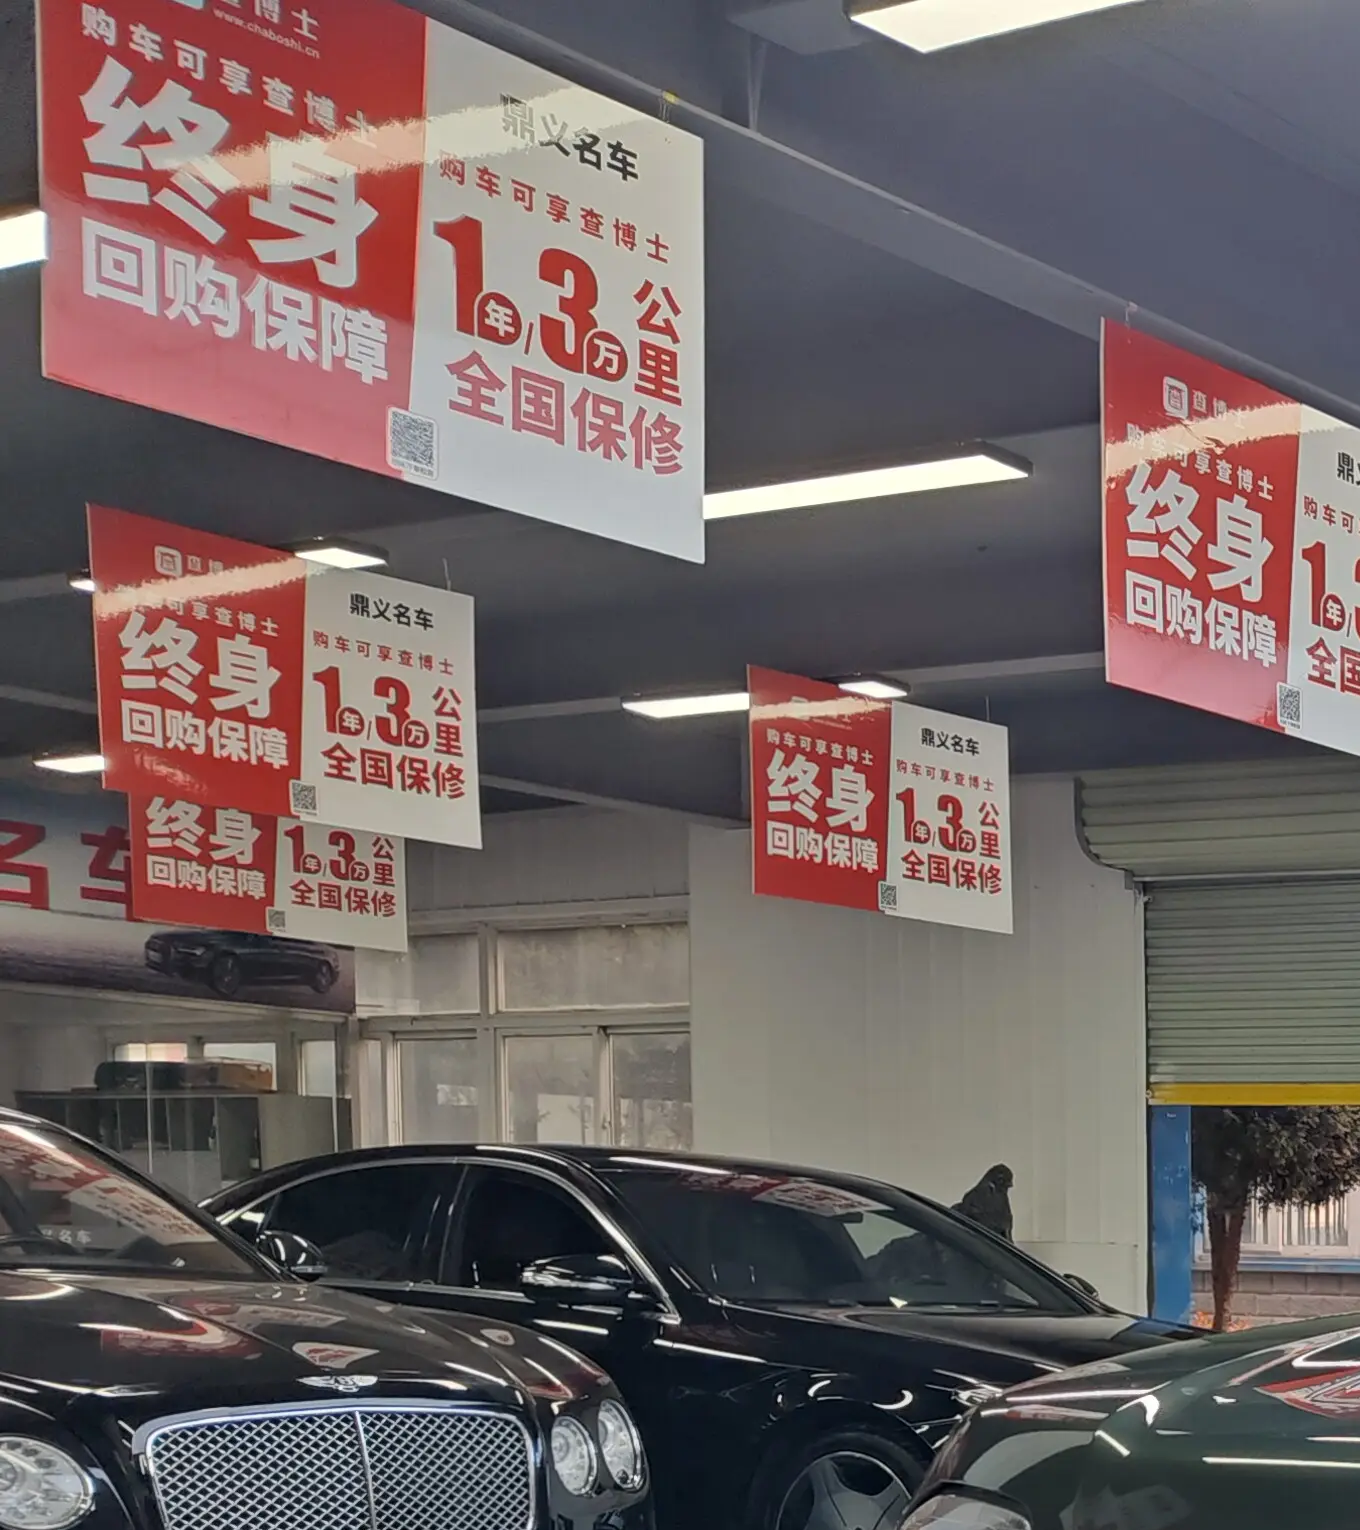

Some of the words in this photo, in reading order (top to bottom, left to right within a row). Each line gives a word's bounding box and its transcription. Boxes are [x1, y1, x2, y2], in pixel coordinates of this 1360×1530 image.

[212, 6, 321, 59] www.chaboshi.cn
[219, 0, 320, 41] 博士
[80, 3, 378, 148] 购车可享查博士
[500, 93, 640, 182] 鼎义名车
[79, 54, 378, 289] 终身
[439, 151, 670, 264] 购车可享查博士
[80, 217, 389, 385] 回购保障
[444, 350, 685, 477] 全国保修
[1125, 462, 1275, 602] 终身
[349, 593, 435, 631] 鼎义名车
[1125, 569, 1277, 668] 回购保障
[118, 611, 281, 719] 终身
[313, 630, 454, 676] 购车可享查博士
[119, 699, 289, 770] 回购保障
[766, 727, 875, 767] 购车可享查博士
[920, 727, 980, 756] 鼎义名车
[321, 742, 466, 800] 全国保修
[767, 748, 875, 832] 终身
[896, 759, 995, 793] 购车可享查博士
[145, 797, 262, 866] 终身
[766, 820, 879, 874] 回购保障
[146, 855, 267, 900] 回购保障
[290, 879, 396, 918] 全国保修
[901, 849, 1003, 895] 全国保修
